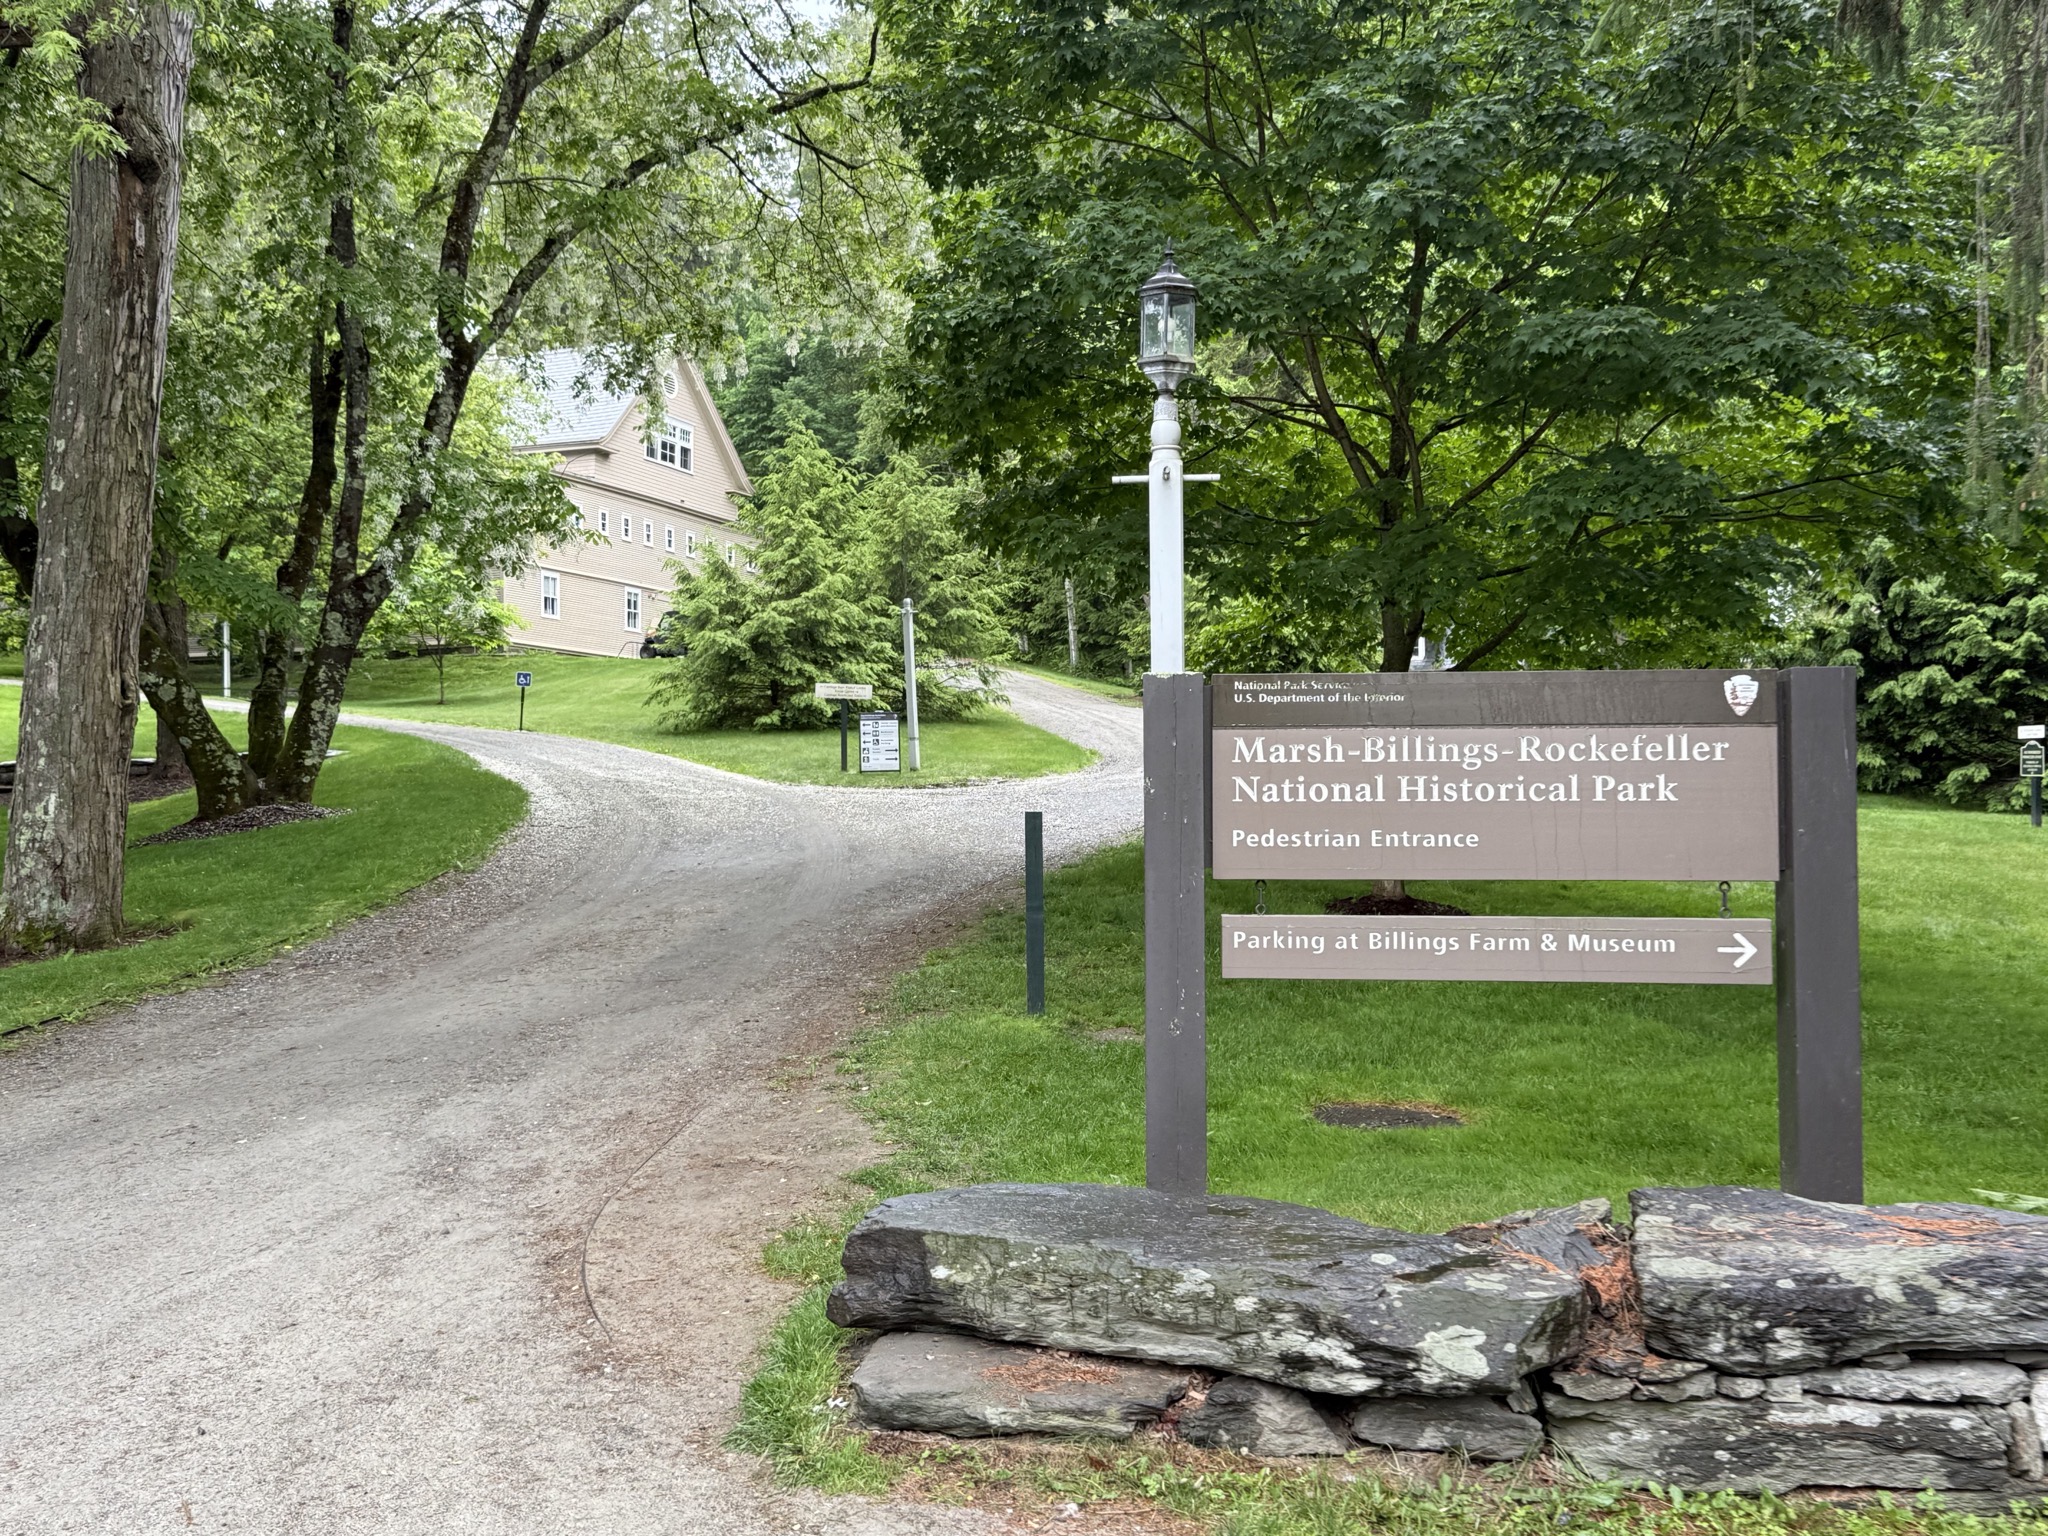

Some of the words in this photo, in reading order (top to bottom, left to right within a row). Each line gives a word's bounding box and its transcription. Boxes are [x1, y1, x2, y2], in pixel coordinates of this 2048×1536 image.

[1234, 680, 1280, 690] National
[1284, 680, 1308, 690] Park
[1234, 693, 1256, 703] U.S.
[1258, 693, 1325, 705] Department
[1327, 692, 1340, 703] of
[1343, 692, 1361, 703] the
[1231, 734, 1730, 771] Marsh-Billings-Rockefeller
[1231, 775, 1386, 803] National
[1397, 773, 1581, 802] Historical
[1592, 773, 1679, 802] Park
[1232, 828, 1360, 848] Pedestrian
[1371, 829, 1480, 848] Entrance
[1233, 930, 1325, 955] Parking
[1334, 933, 1359, 951] at
[1369, 931, 1460, 956] Billings
[1470, 933, 1531, 952] Farm
[1540, 933, 1558, 953] &
[1568, 934, 1677, 953] Museum
